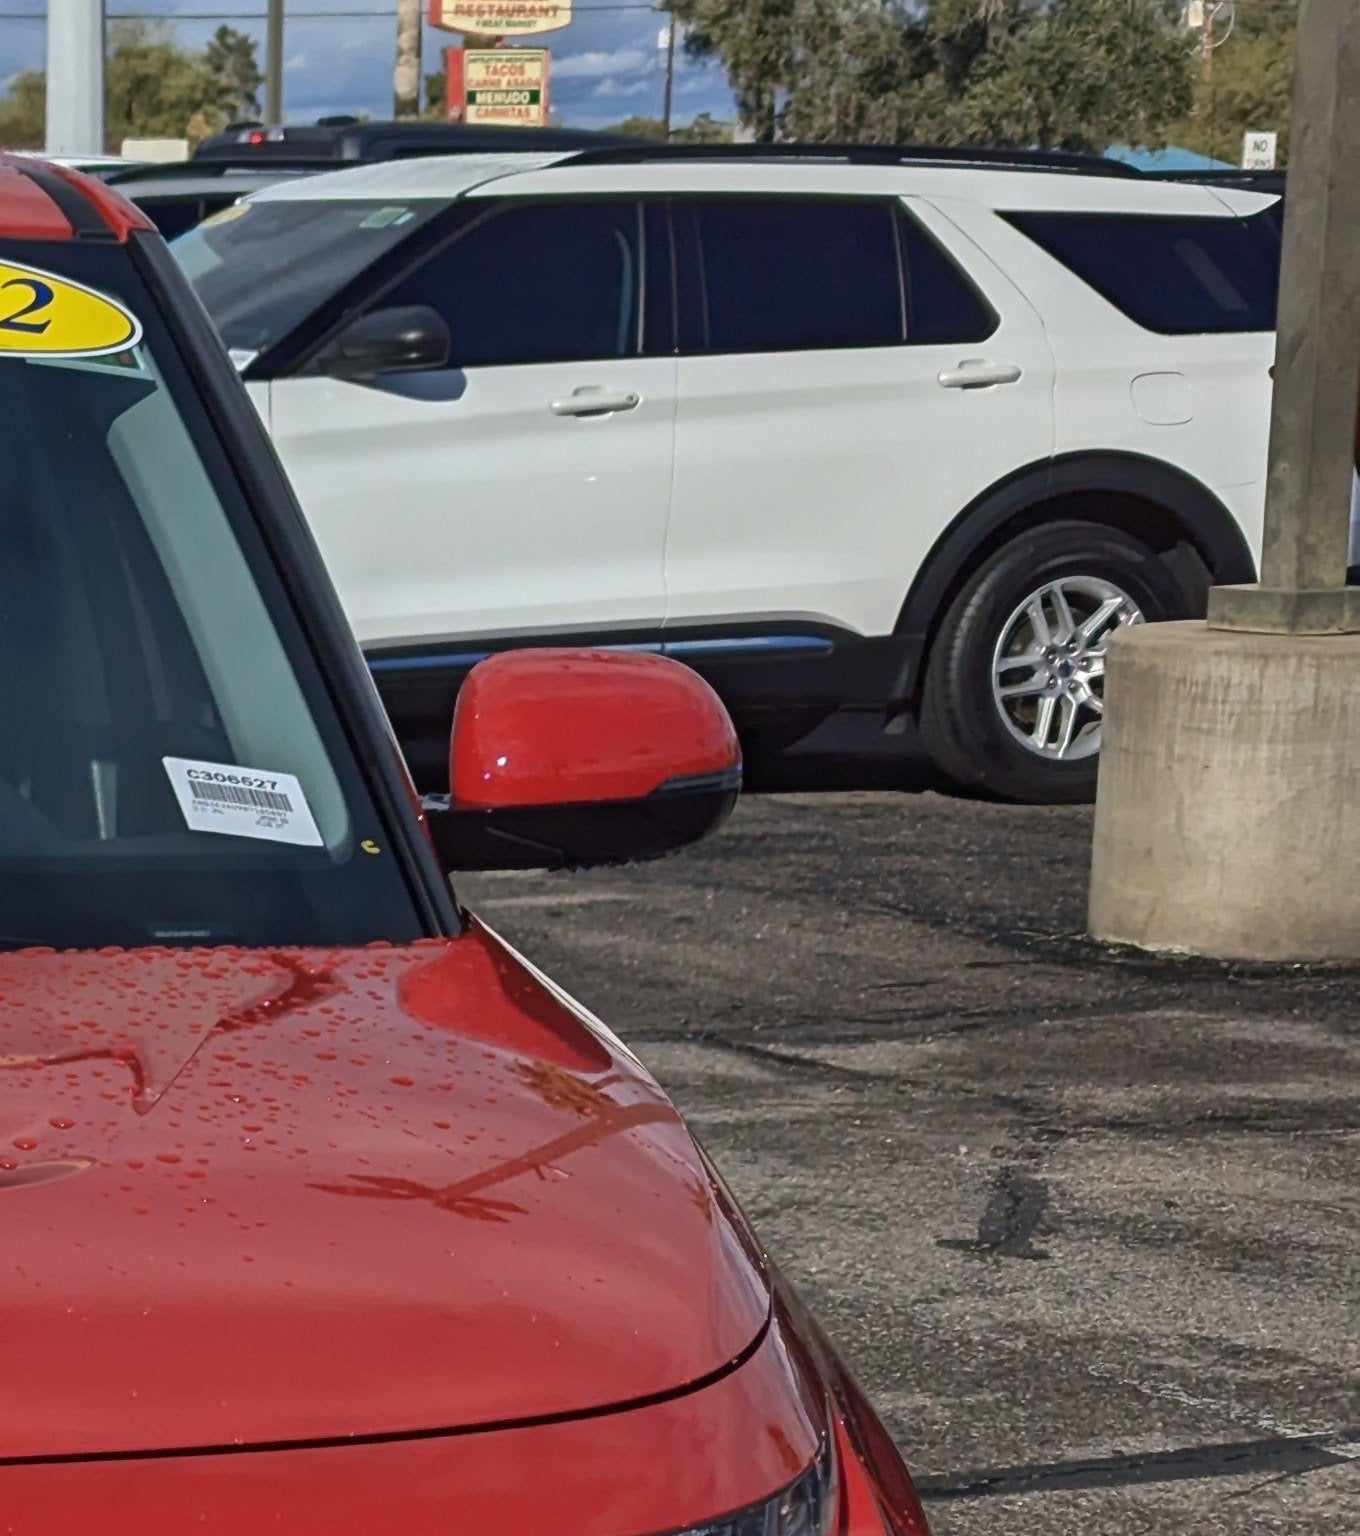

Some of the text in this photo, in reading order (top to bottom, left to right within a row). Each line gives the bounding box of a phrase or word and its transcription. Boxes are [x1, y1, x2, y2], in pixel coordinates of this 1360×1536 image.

[454, 4, 559, 17] RESTAURANT
[484, 64, 525, 76] TACOS
[475, 91, 530, 104] MENUDO
[1253, 140, 1268, 151] NO
